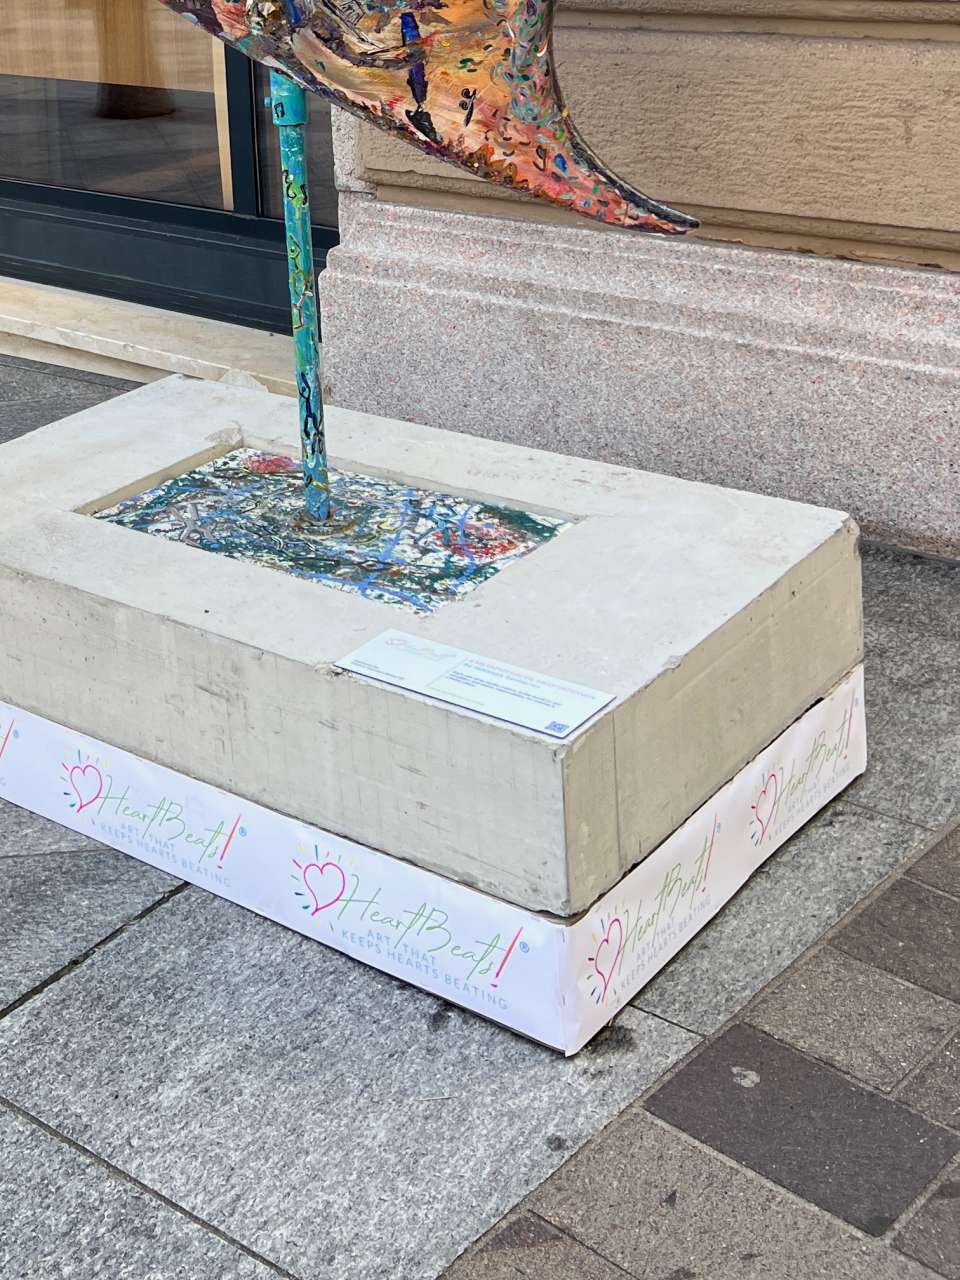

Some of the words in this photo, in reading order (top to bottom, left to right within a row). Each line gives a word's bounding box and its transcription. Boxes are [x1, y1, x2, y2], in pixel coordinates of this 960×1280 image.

[100, 822, 133, 845] KEEPS
[136, 838, 178, 864] HEARTS
[181, 858, 232, 888] BEATING
[121, 823, 141, 837] ART
[149, 832, 175, 851] THAT
[342, 929, 381, 954] KEEPS
[387, 950, 439, 979] HEARTS
[444, 974, 509, 1011] BEATING
[367, 929, 391, 946] ART
[403, 942, 437, 966] THAT
